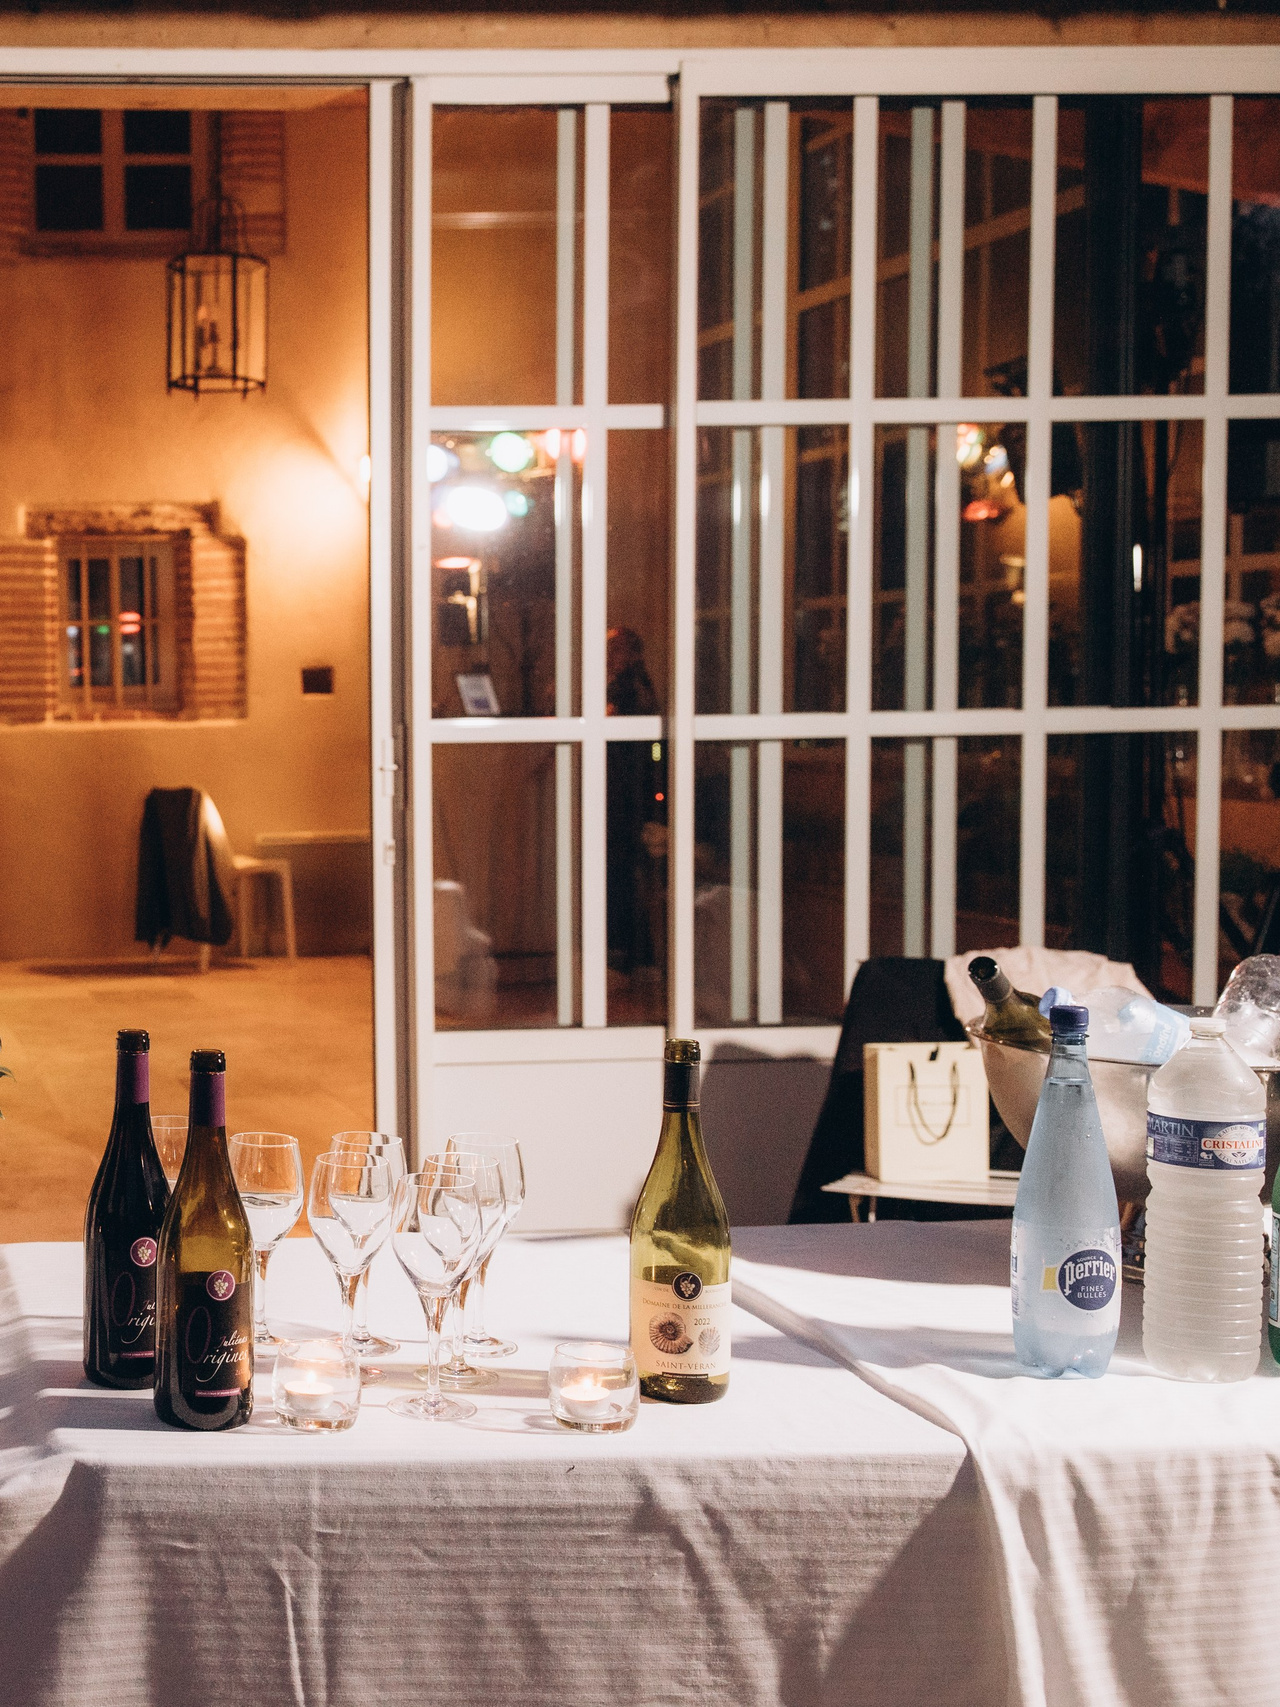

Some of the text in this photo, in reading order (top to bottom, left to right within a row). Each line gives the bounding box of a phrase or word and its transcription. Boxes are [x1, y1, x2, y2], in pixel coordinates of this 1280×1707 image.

[1080, 1284, 1104, 1292] FINES
[1077, 1291, 1107, 1299] BULLES
[642, 1298, 670, 1309] DOMAINE
[693, 1318, 711, 1326] 2022
